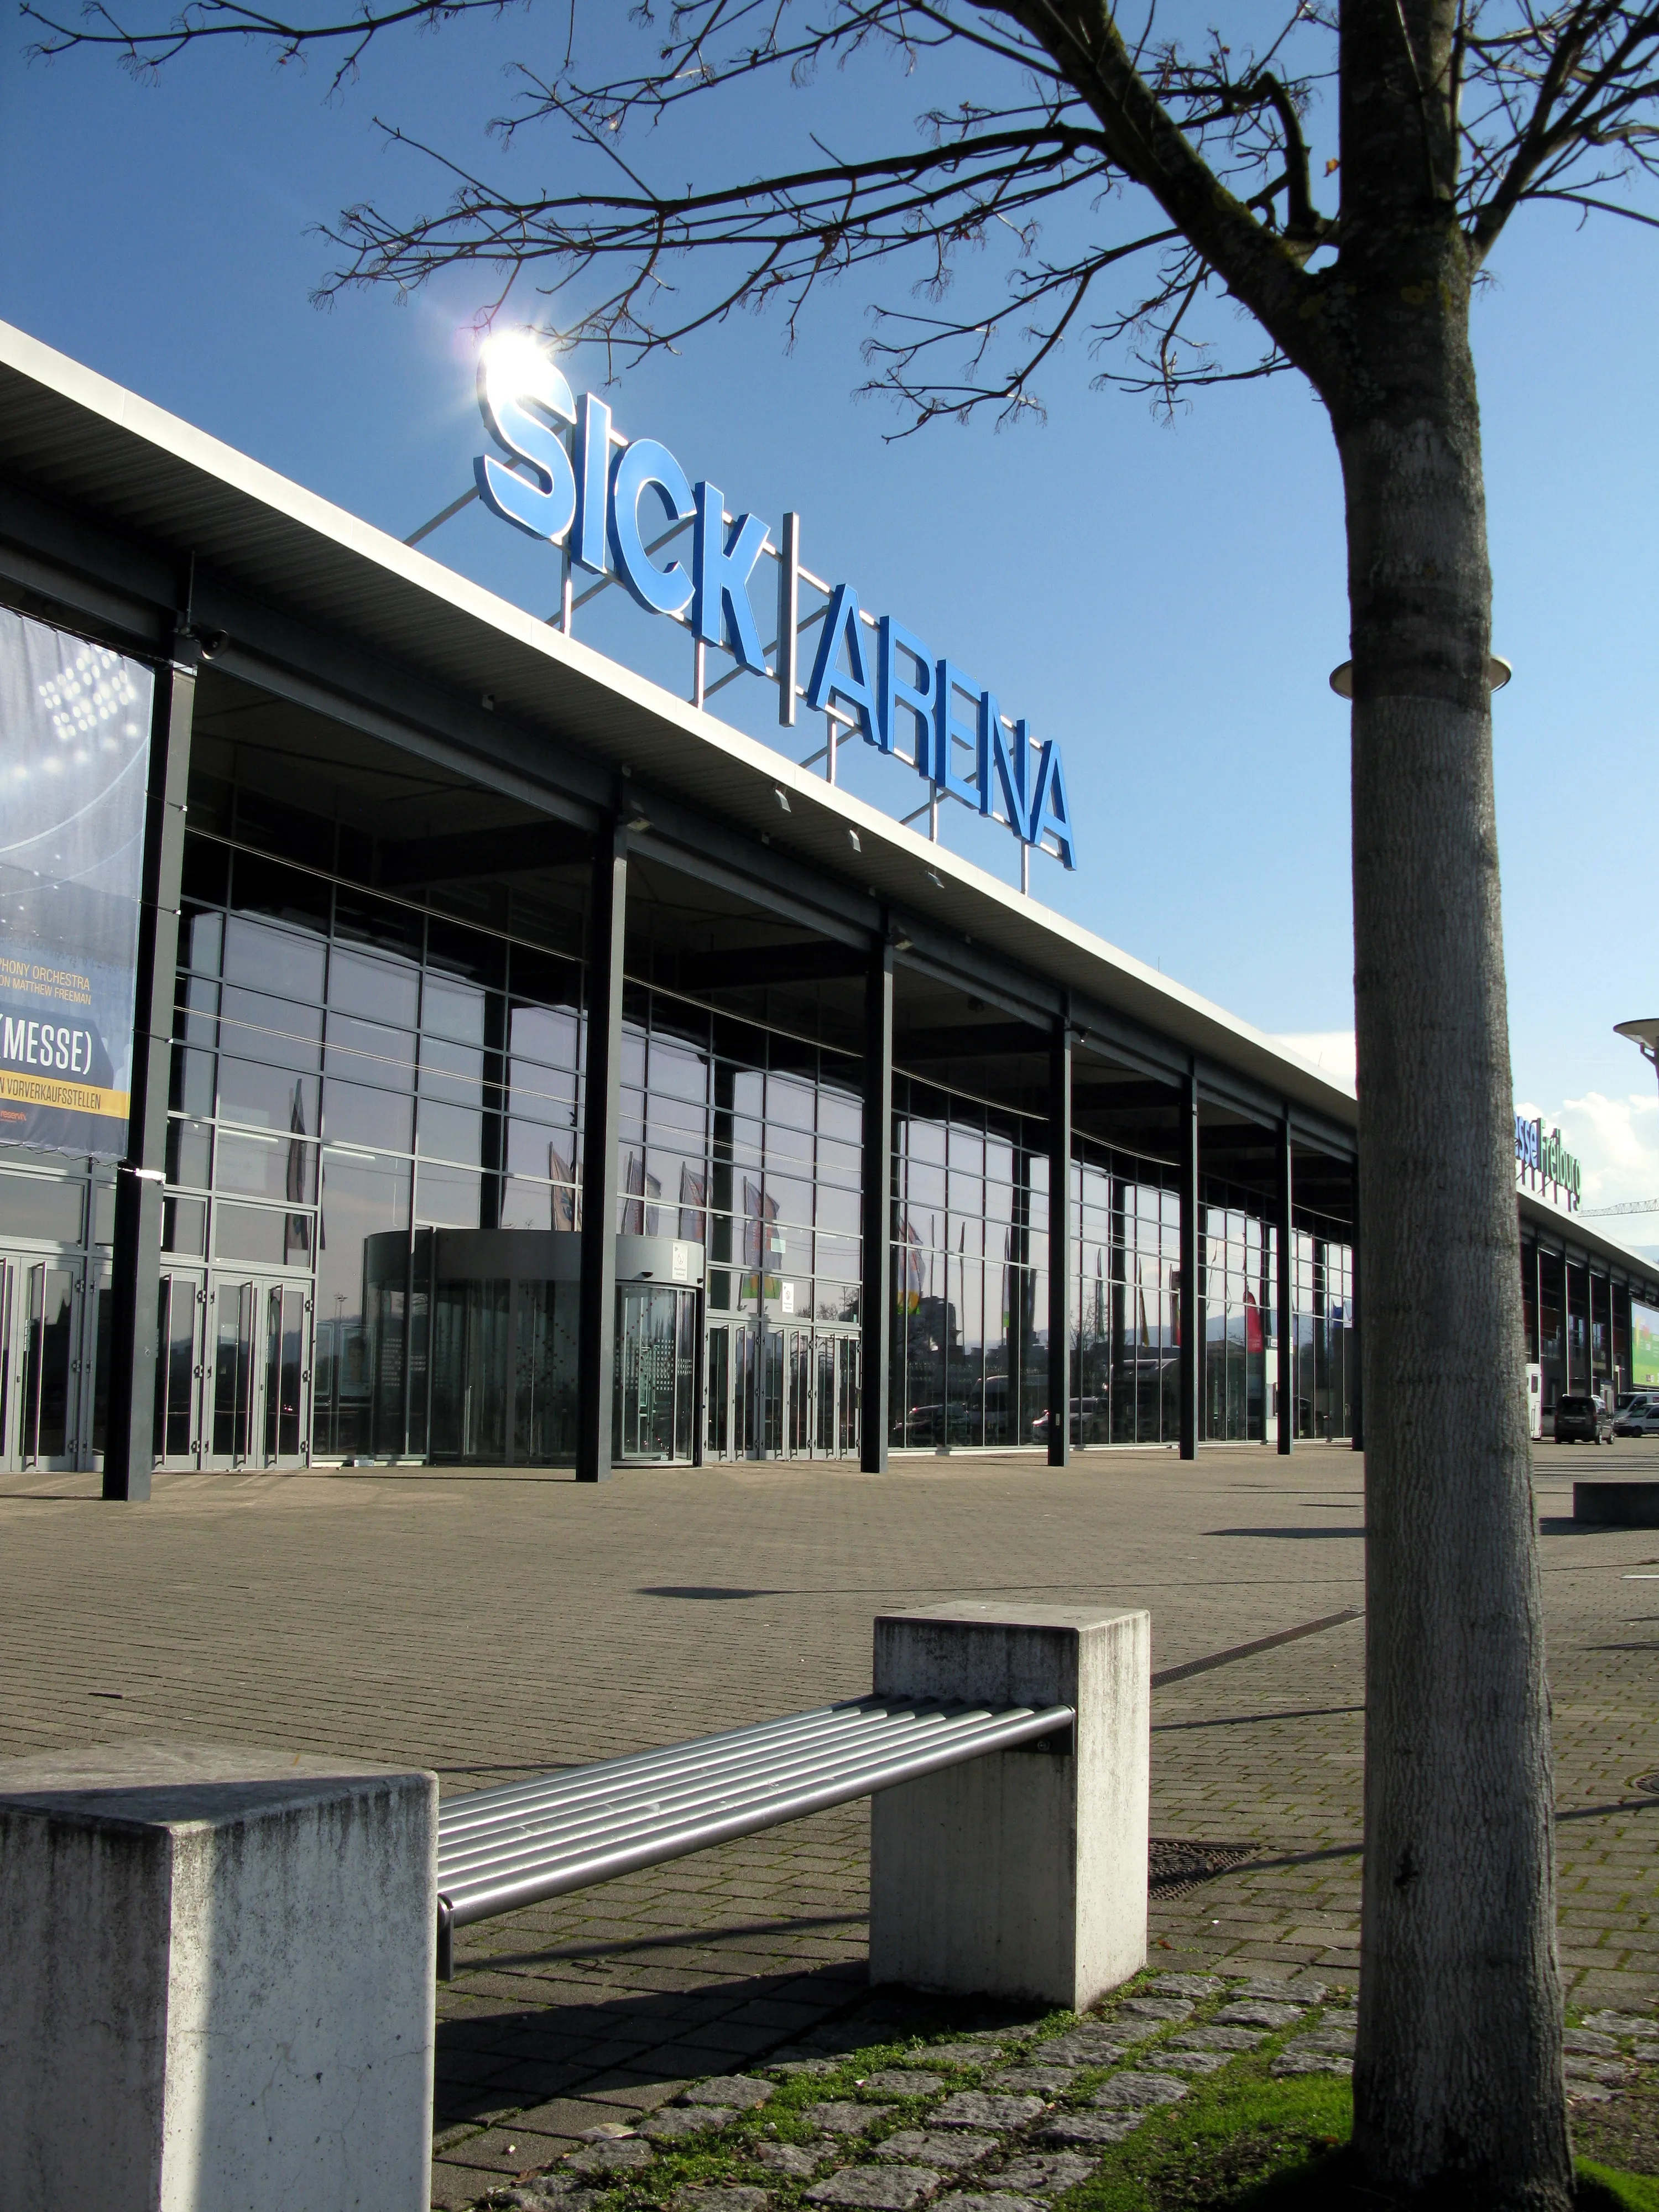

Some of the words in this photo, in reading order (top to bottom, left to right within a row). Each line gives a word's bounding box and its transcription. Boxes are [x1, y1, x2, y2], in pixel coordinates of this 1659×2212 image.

[473, 332, 771, 677] SICK
[806, 582, 1076, 871] ARENA
[13, 977, 53, 997] MATTHEW
[54, 987, 91, 1005] FREEMAN
[33, 966, 91, 992] ORCHESTRA
[7, 1078, 101, 1110] VORVERKAUFSSTELLEN
[1537, 1117, 1582, 1212] Freiburg
